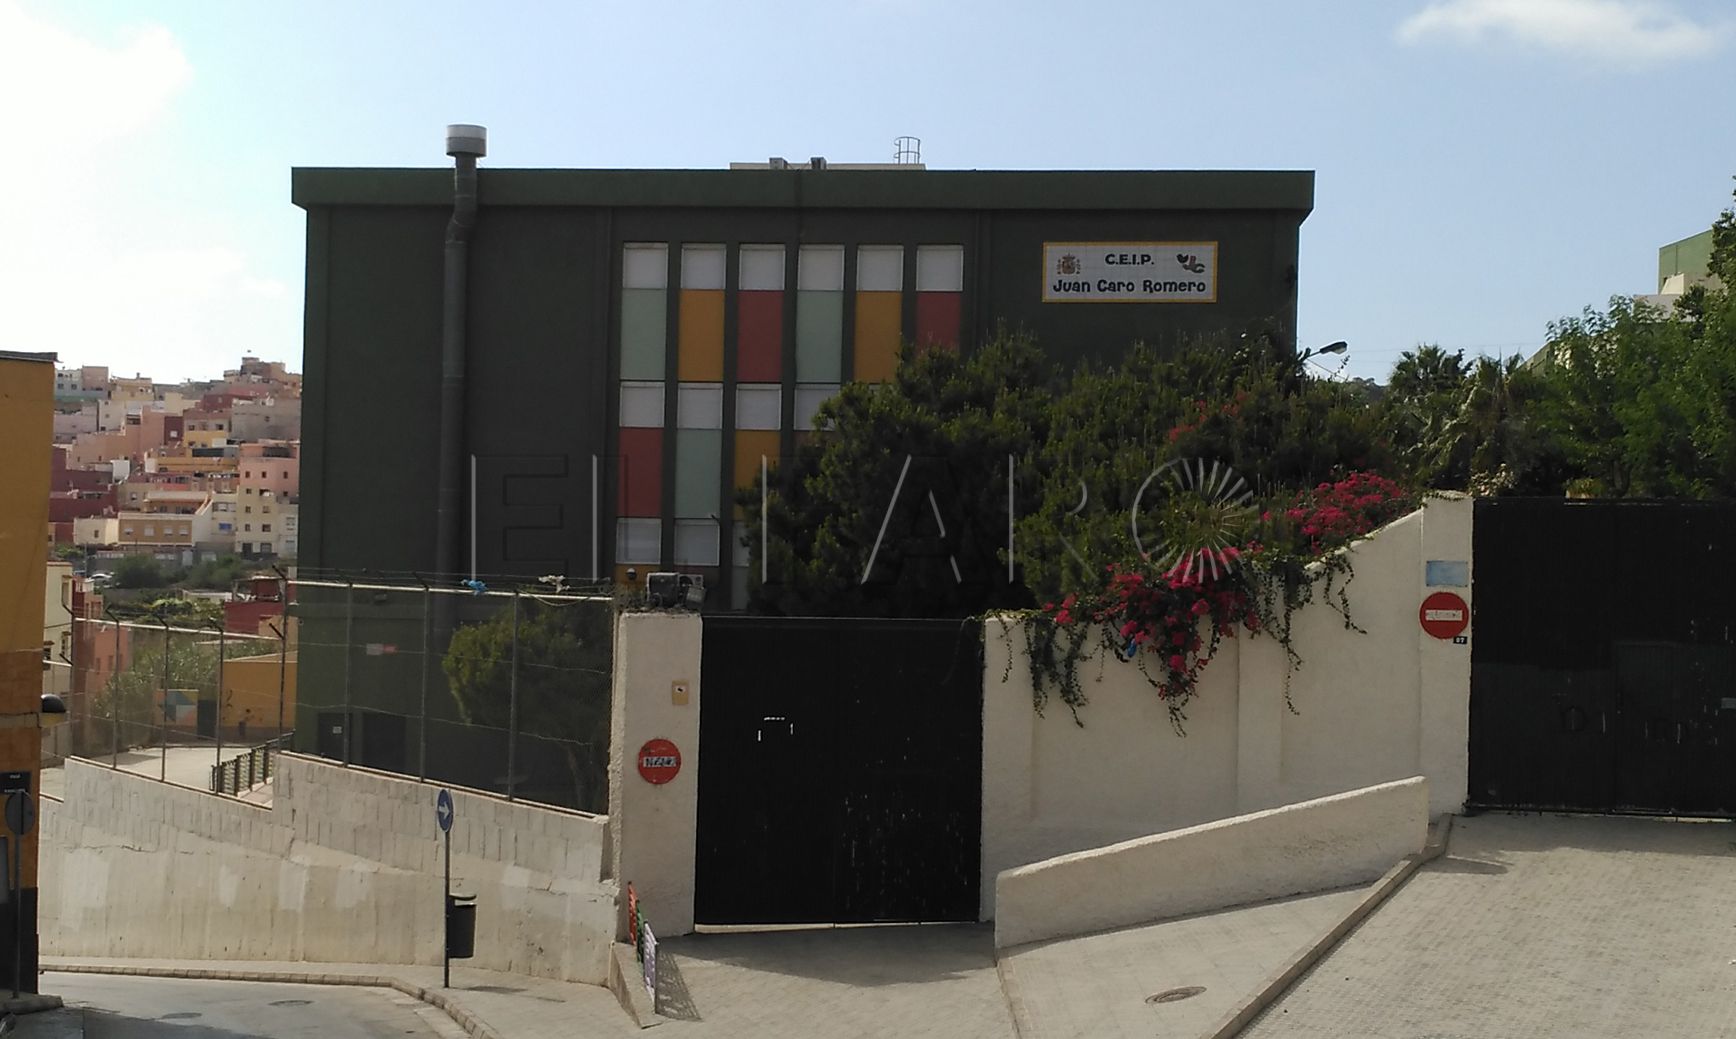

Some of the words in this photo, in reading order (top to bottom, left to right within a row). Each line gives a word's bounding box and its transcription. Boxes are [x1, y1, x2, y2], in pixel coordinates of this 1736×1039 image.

[1105, 254, 1155, 265] C.E.I.P.
[1053, 280, 1091, 293] Juan
[1097, 280, 1135, 293] Caro
[1142, 280, 1206, 293] Romero
